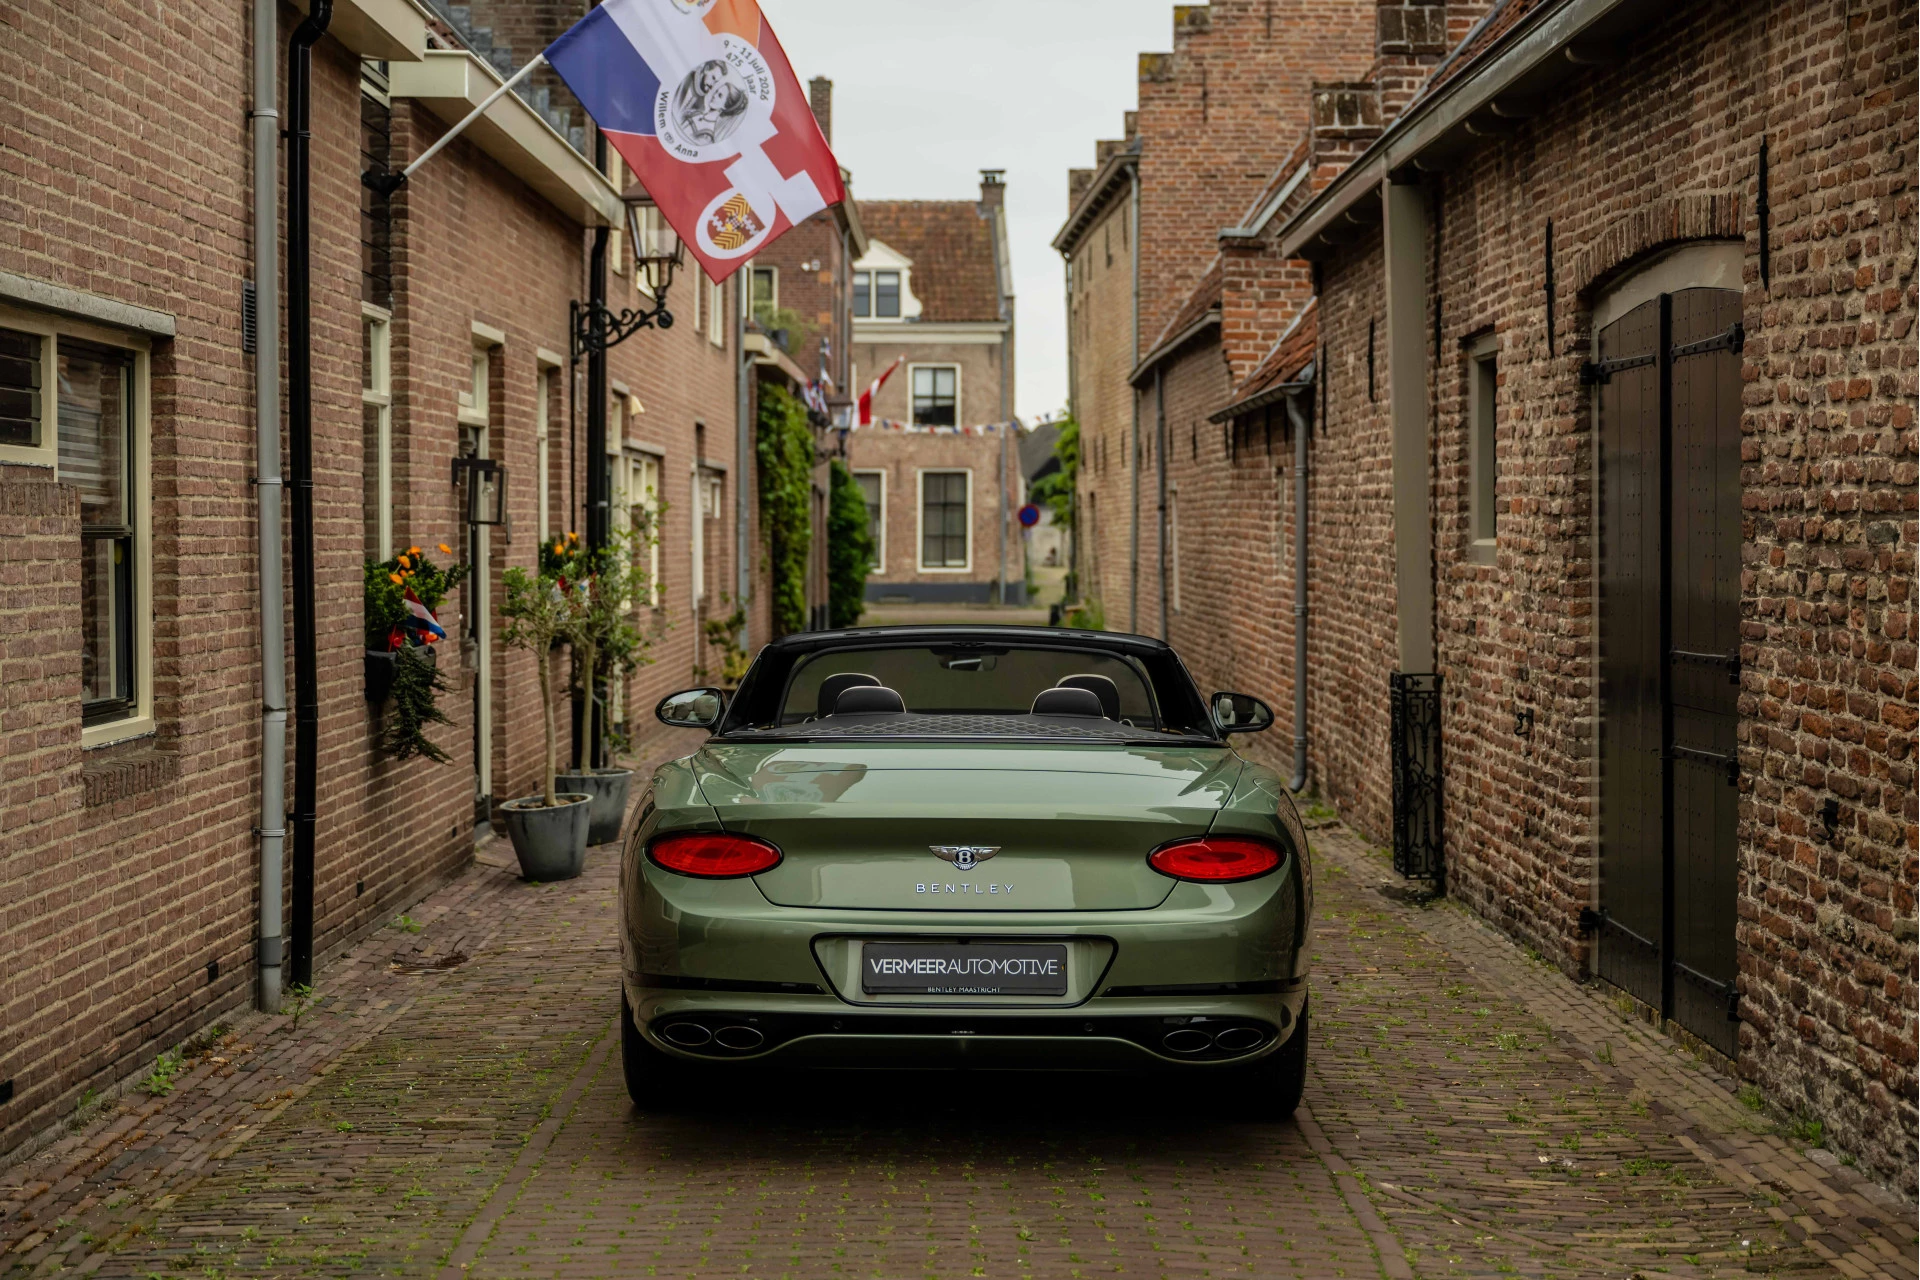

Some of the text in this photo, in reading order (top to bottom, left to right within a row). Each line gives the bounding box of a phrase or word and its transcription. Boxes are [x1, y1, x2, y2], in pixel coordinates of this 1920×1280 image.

[723, 39, 730, 49] 9
[740, 47, 752, 60] 11
[758, 76, 770, 101] 2026
[725, 52, 757, 95] 475 jaar
[658, 91, 699, 158] Willem Anna
[916, 883, 1014, 894] BENTLEY
[870, 958, 1058, 975] VERMEERAUTOMOTIVE
